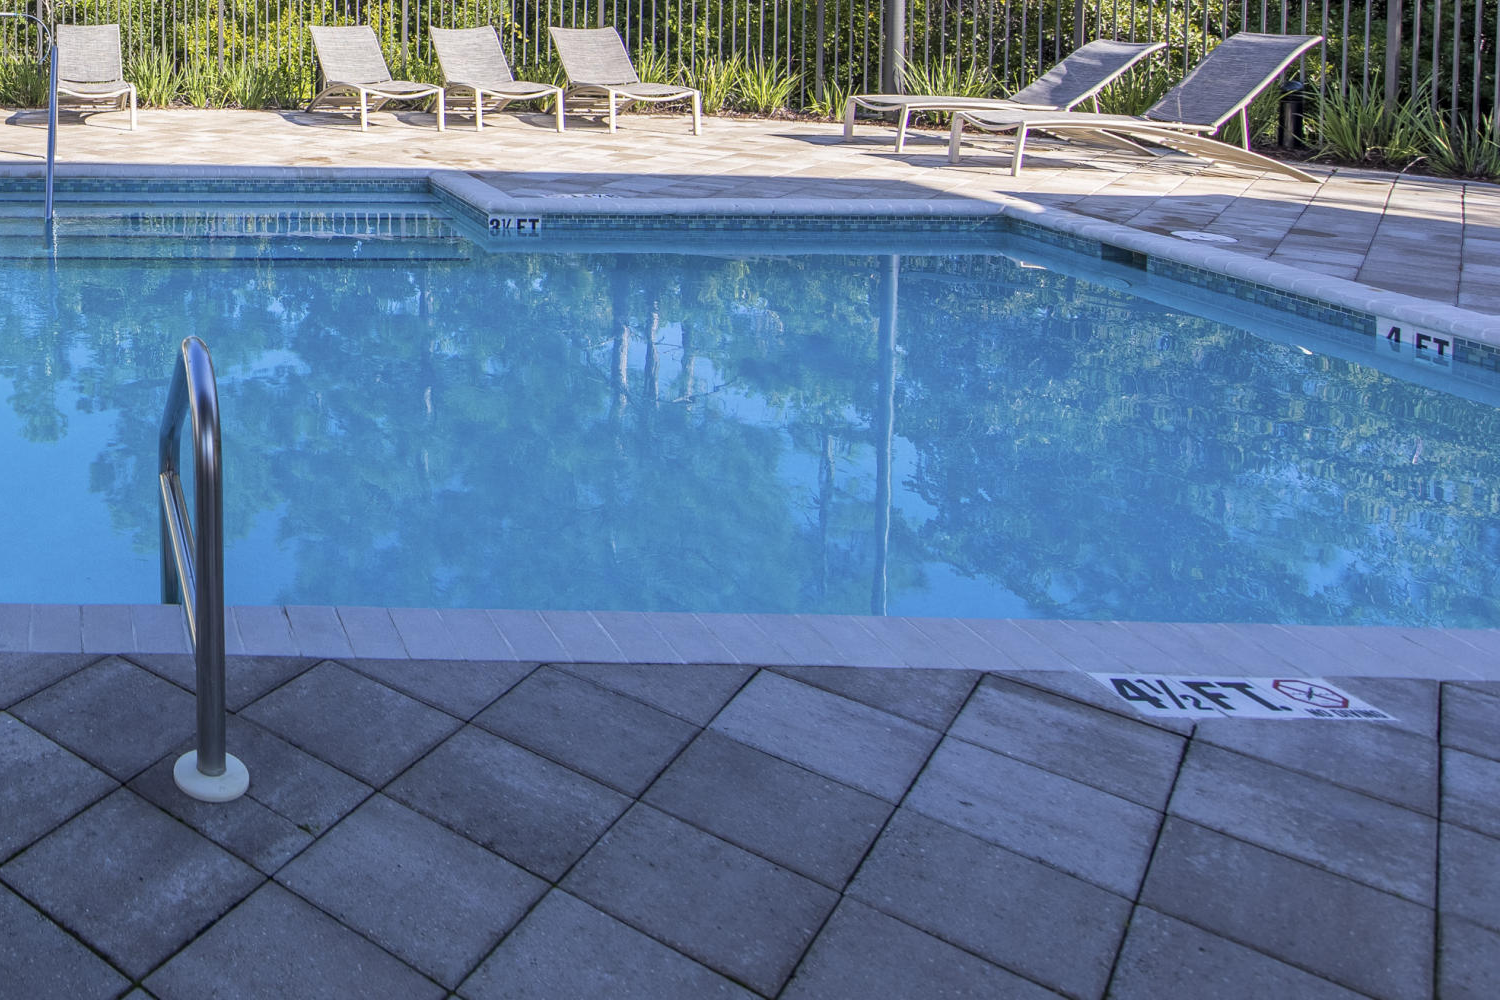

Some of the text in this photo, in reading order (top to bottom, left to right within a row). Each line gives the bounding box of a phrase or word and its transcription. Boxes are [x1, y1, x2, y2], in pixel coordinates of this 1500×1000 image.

[1416, 332, 1450, 356] FT
[1304, 708, 1389, 719] NO DIVING
